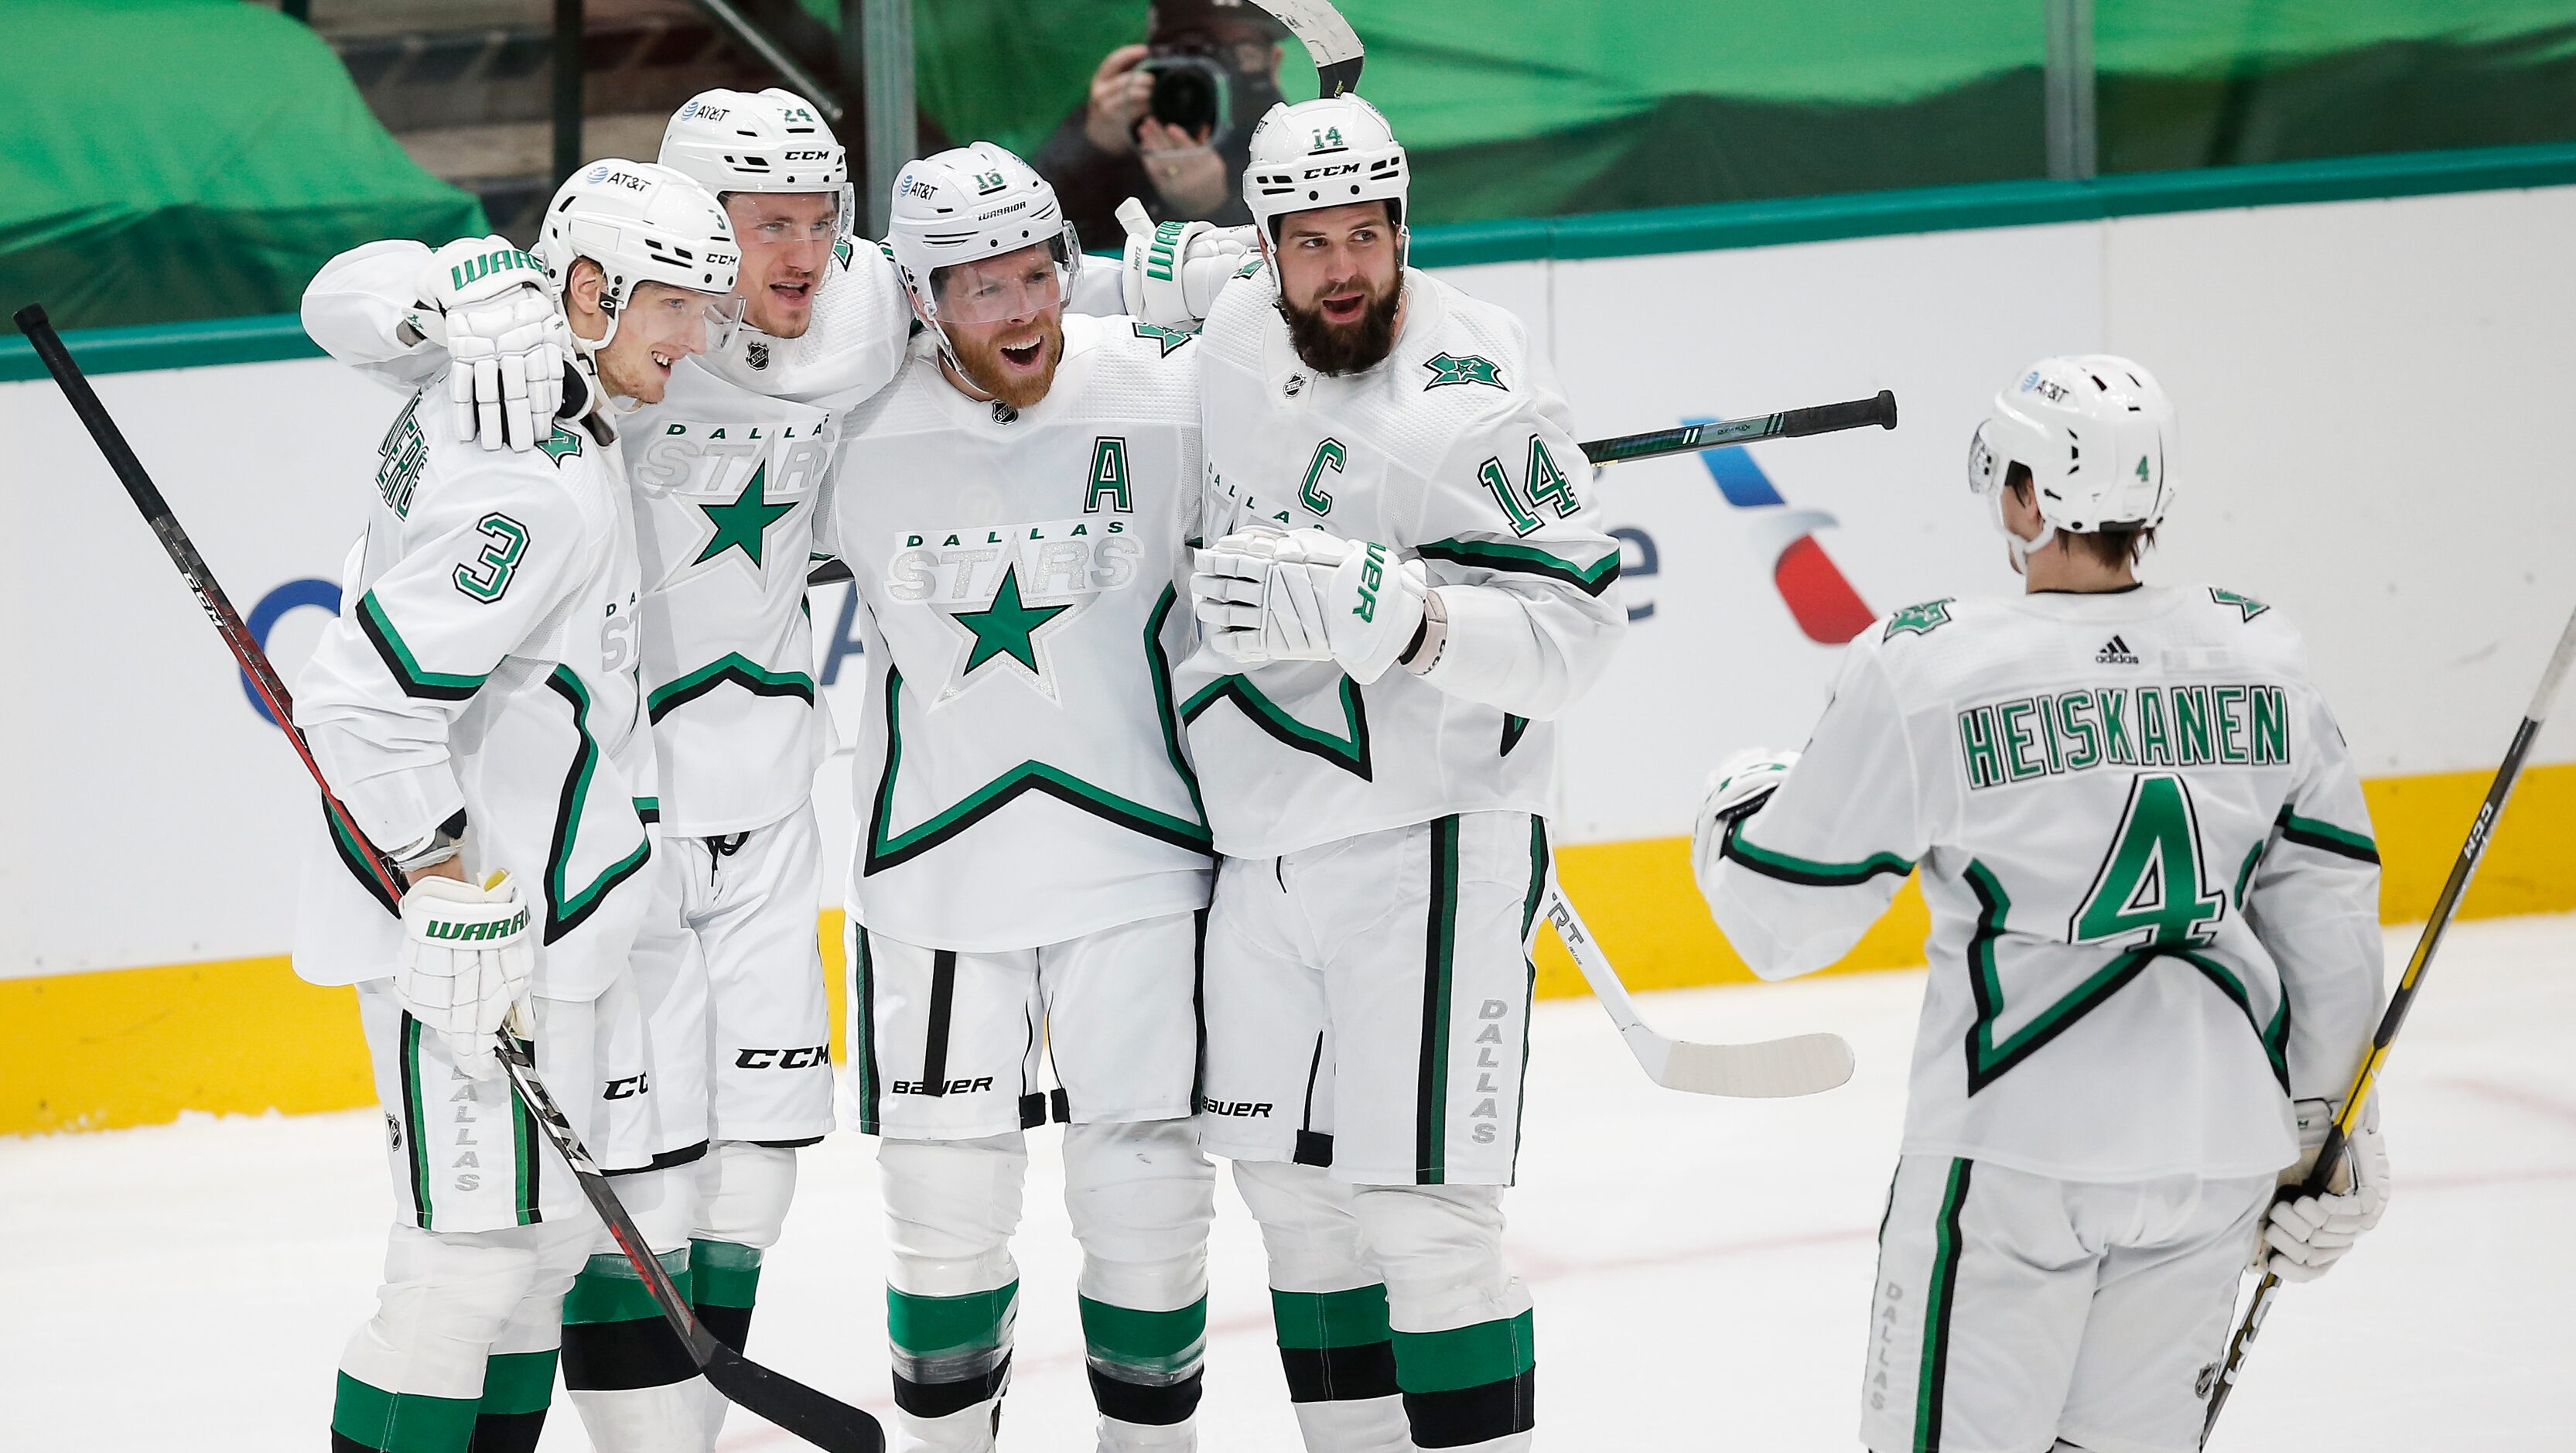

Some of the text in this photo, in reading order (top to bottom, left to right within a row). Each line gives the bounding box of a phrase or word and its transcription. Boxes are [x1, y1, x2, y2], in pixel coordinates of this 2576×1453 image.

[695, 105, 730, 122] AT&T
[777, 108, 814, 122] 24
[1312, 126, 1343, 149] 14
[785, 151, 830, 160] CCM
[607, 173, 651, 192] AT&T
[1304, 163, 1361, 179] CCM
[910, 182, 938, 200] AT&T
[979, 201, 1027, 221] WARRIOR
[706, 253, 737, 265] CCM
[1133, 246, 1142, 271] HINTZ
[1084, 436, 1133, 513] A
[1298, 437, 1347, 517] C
[2136, 455, 2149, 482] 4
[1478, 434, 1581, 538] 14
[907, 521, 1124, 547] DALLAS
[452, 511, 531, 604] 3
[889, 532, 1139, 600] STARS
[183, 571, 224, 627] CCM
[2096, 654, 2139, 664] adidas
[1958, 685, 2290, 790] HEISKANEN
[2463, 802, 2494, 860] CCM
[2069, 772, 2226, 954] 4
[735, 1043, 828, 1069] CCM
[1469, 999, 1508, 1144] DALLAS
[1870, 1280, 1904, 1410] DALLAS
